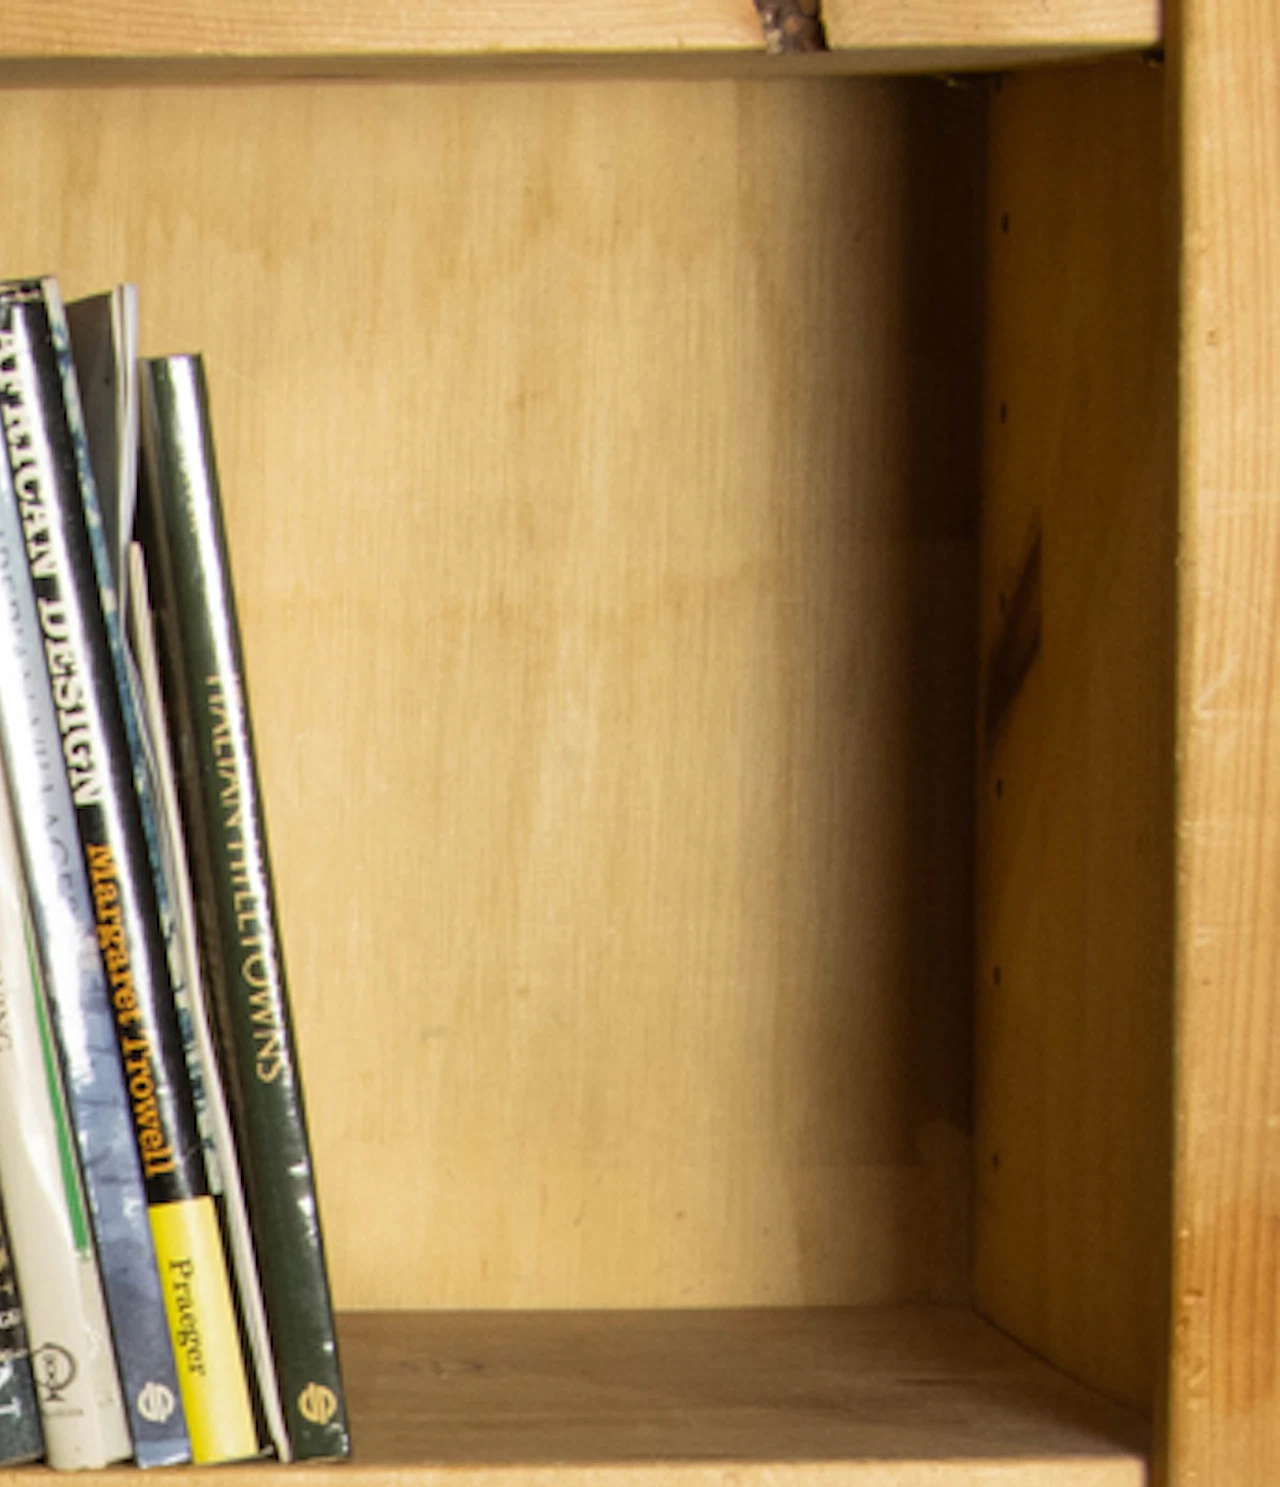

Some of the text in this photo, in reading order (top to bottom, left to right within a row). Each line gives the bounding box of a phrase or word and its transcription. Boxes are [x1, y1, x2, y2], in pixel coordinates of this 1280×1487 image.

[82, 841, 177, 1176] Margaret Trowell
[163, 1257, 212, 1377] Praeger
